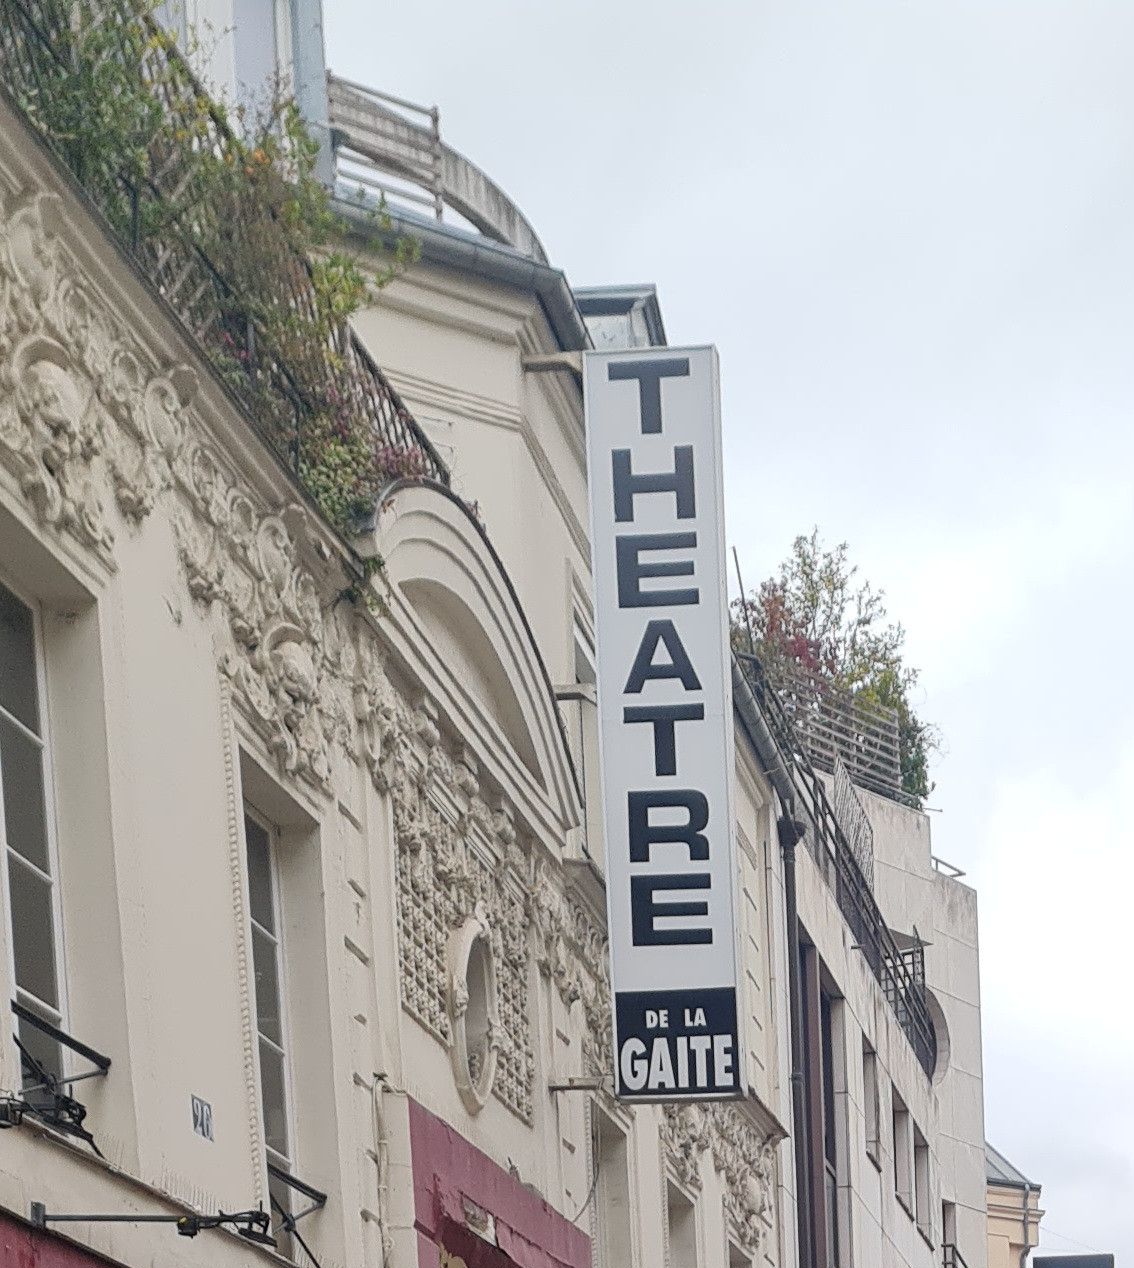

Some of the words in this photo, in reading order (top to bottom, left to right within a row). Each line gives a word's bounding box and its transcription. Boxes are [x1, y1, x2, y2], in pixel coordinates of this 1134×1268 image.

[608, 357, 713, 947] THEATRE
[645, 1009, 669, 1029] DE
[684, 1007, 707, 1027] LA
[620, 1034, 734, 1091] GAITE
